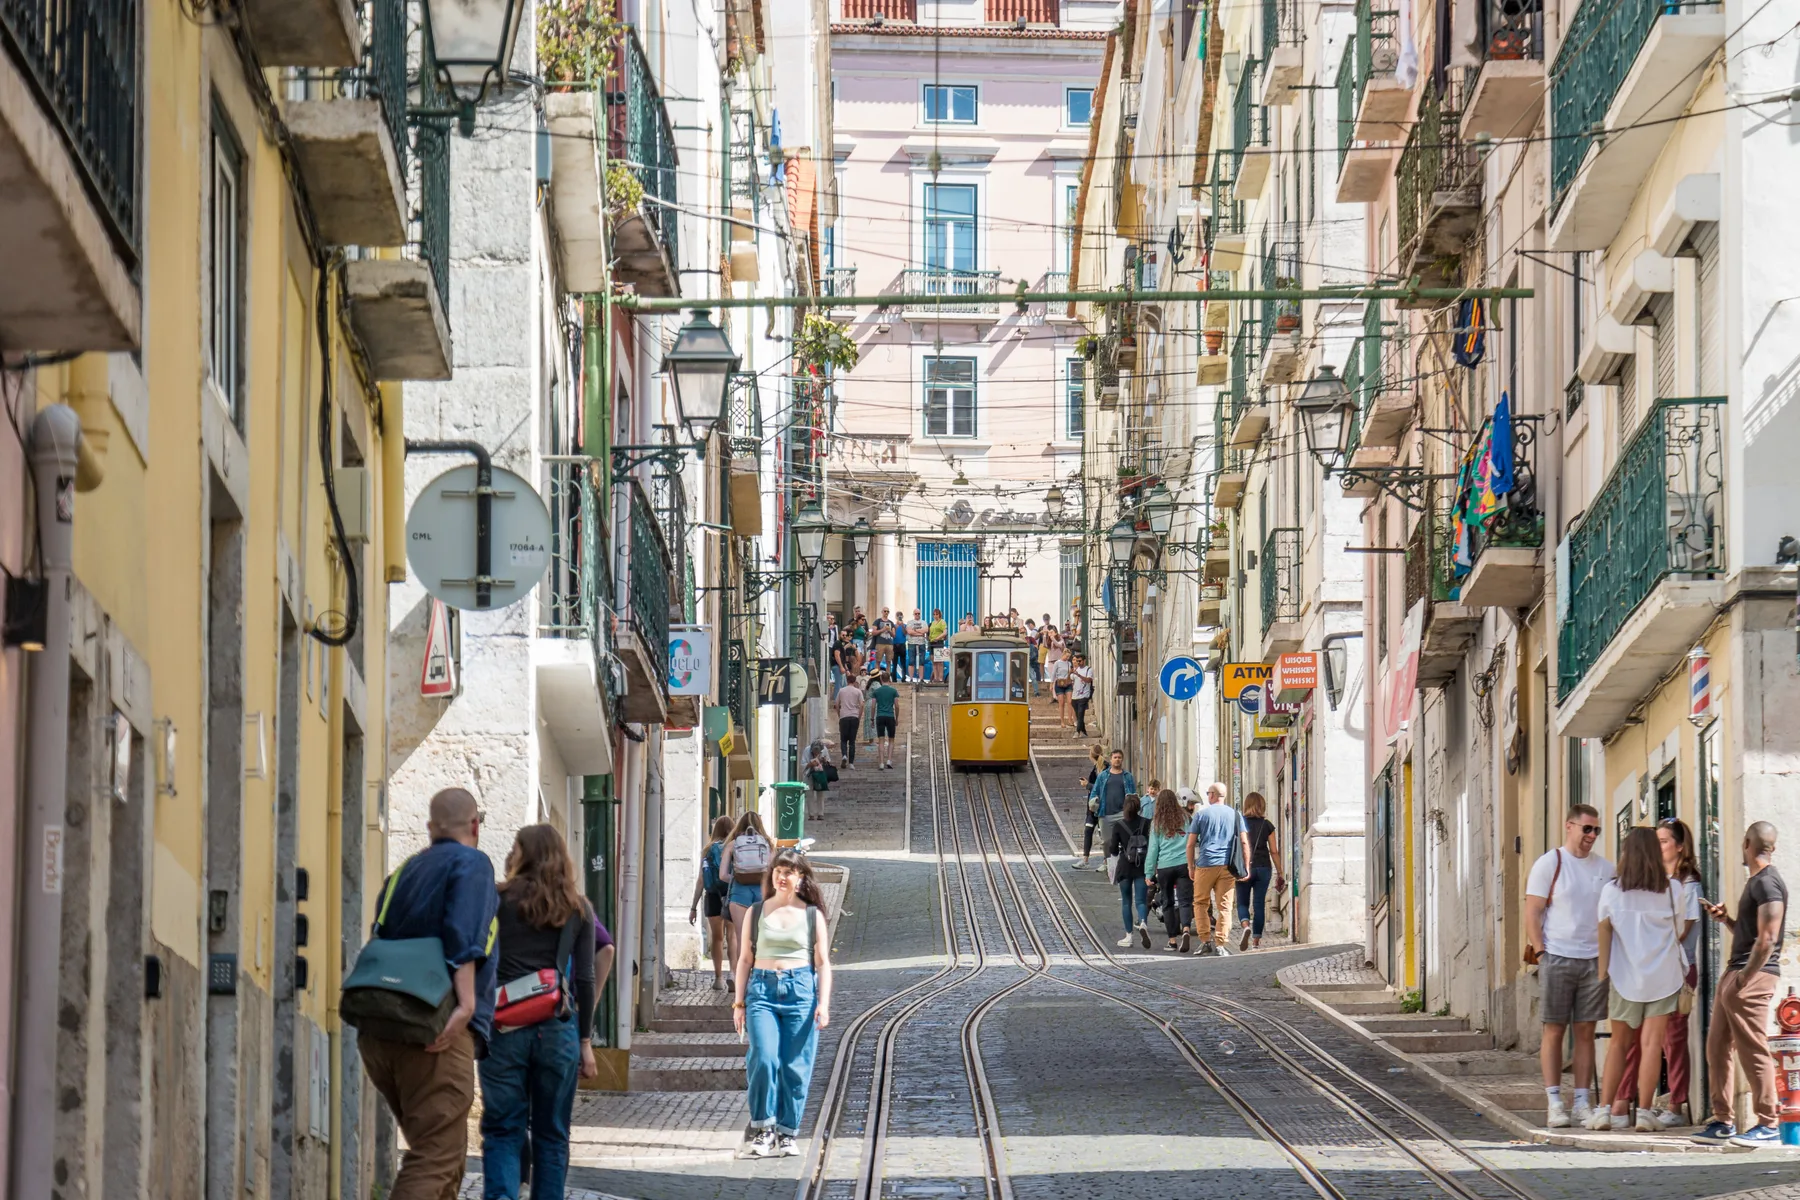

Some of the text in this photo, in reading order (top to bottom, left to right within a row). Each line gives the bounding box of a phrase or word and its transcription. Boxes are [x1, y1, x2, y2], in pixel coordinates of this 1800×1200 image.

[412, 532, 432, 541] CML
[1285, 656, 1312, 664] UISQUE
[1233, 666, 1273, 679] ATM
[1281, 666, 1316, 674] WHISKEY
[1284, 677, 1315, 685] WHISKI
[1273, 703, 1295, 711] VIN
